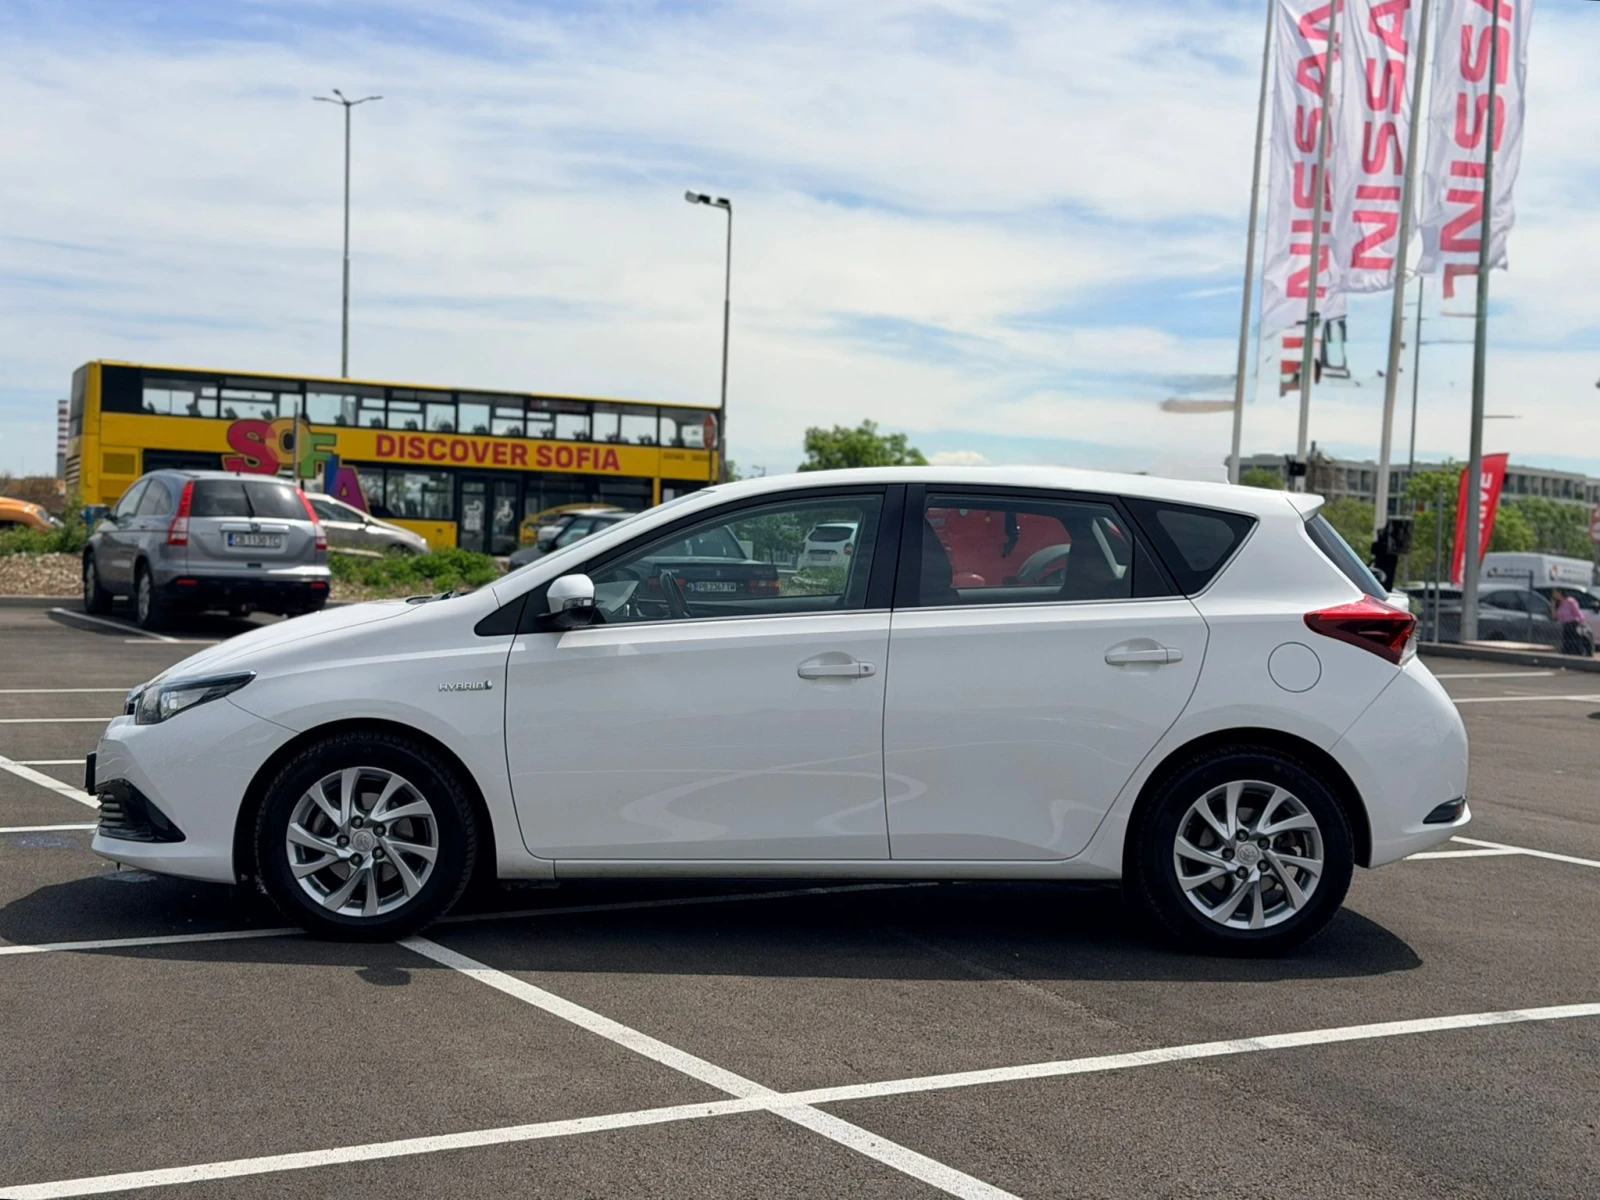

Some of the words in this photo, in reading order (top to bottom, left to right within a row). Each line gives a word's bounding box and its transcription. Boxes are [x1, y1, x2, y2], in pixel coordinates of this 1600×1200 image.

[376, 434, 529, 466] DISCOVER
[536, 445, 621, 471] SOFIA
[438, 682, 484, 692] HYBRID
